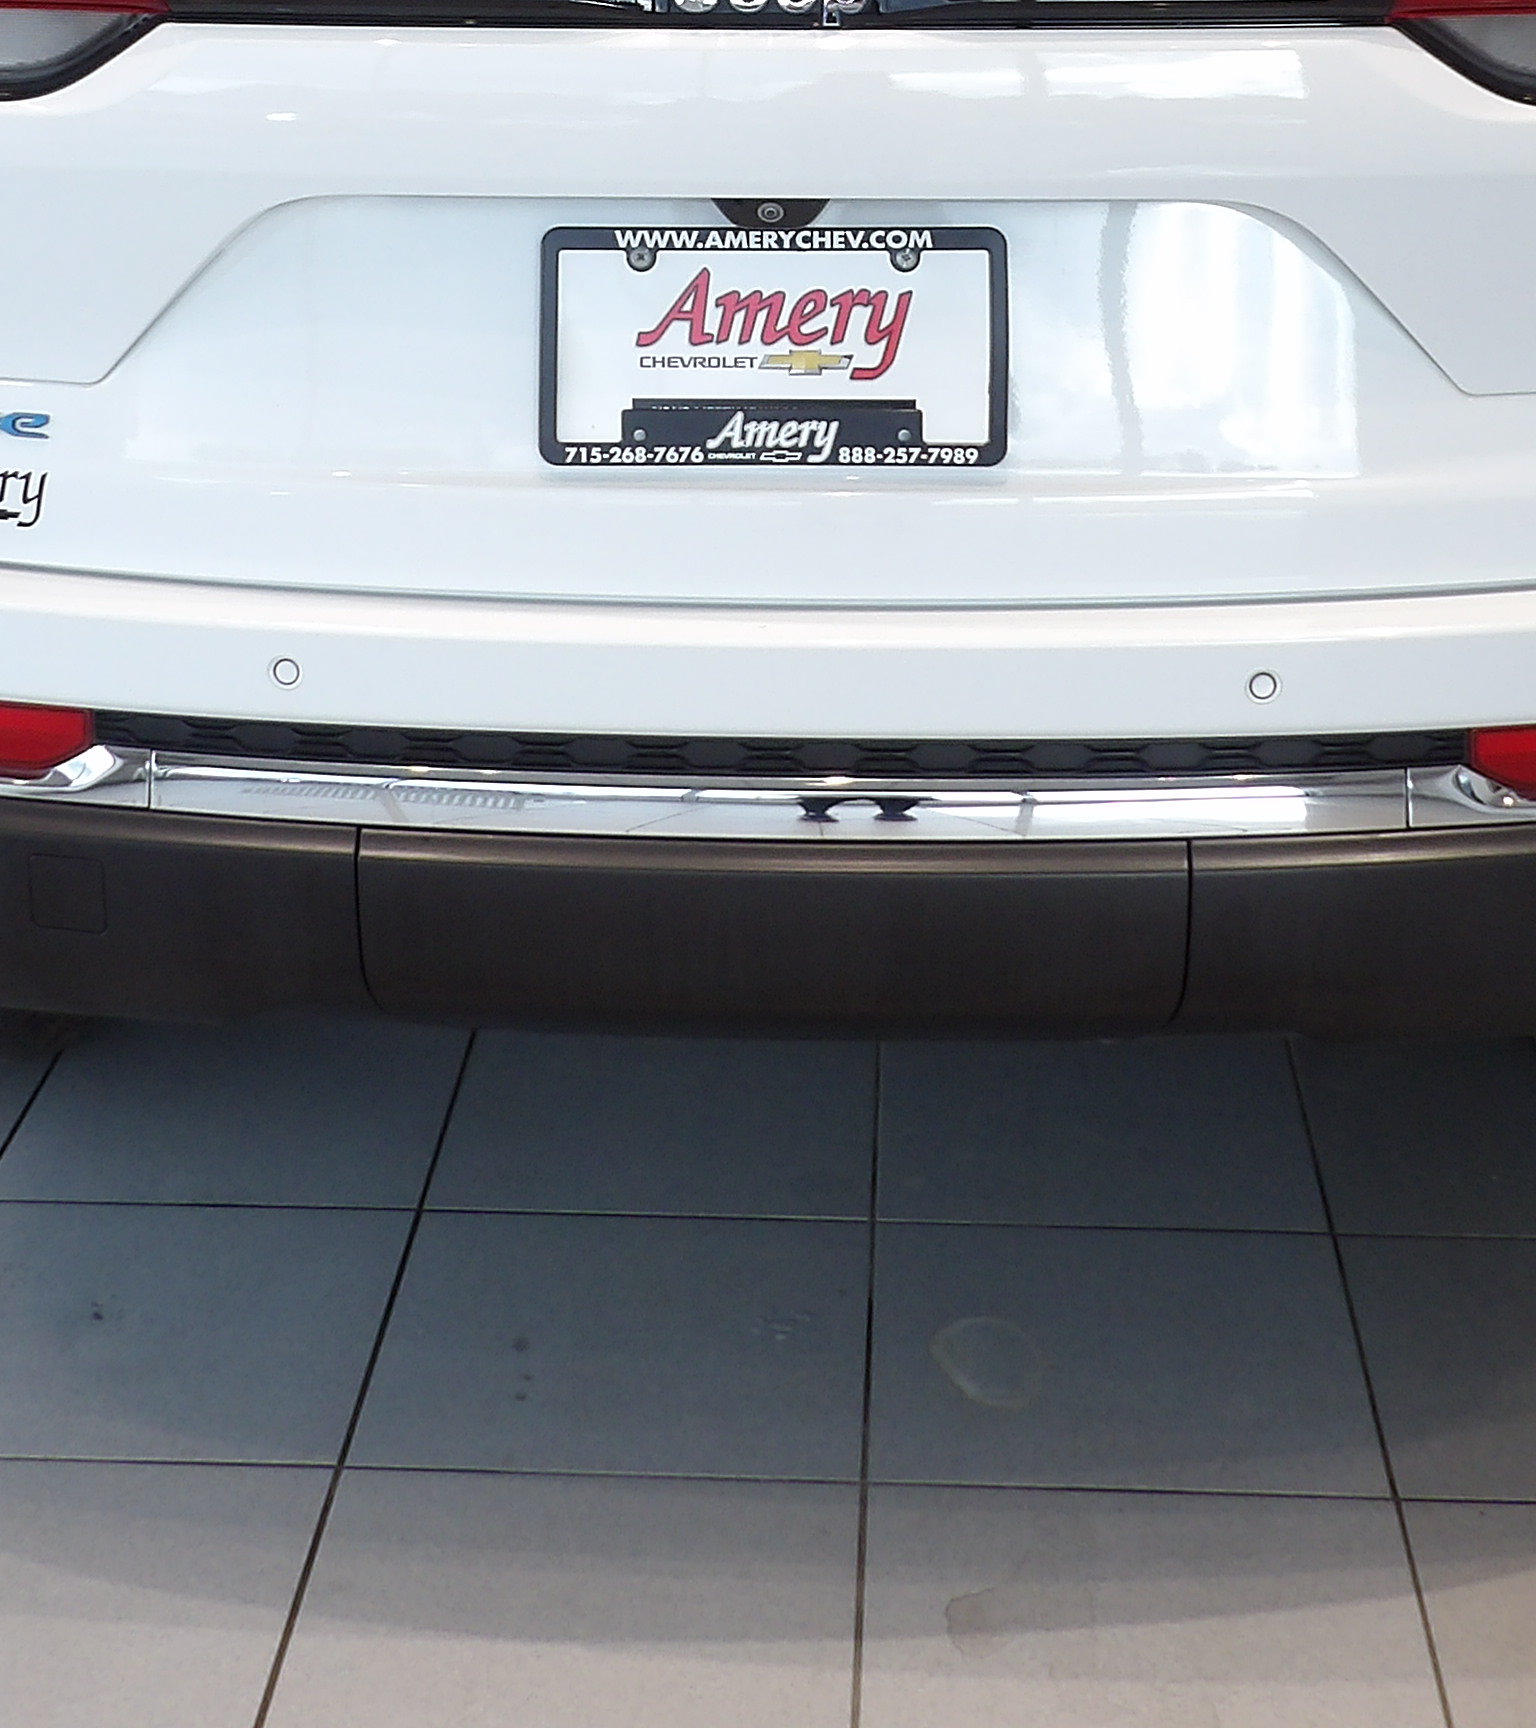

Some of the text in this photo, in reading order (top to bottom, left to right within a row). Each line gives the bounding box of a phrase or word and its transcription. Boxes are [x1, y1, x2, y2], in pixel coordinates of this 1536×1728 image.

[614, 229, 934, 249] WWW.AMERYCHEV.COM
[636, 266, 915, 381] Amery
[639, 355, 759, 369] CHEVROLET
[706, 411, 840, 463] Amery
[564, 446, 705, 464] 715-268-7676
[838, 446, 979, 465] 888-257-7989
